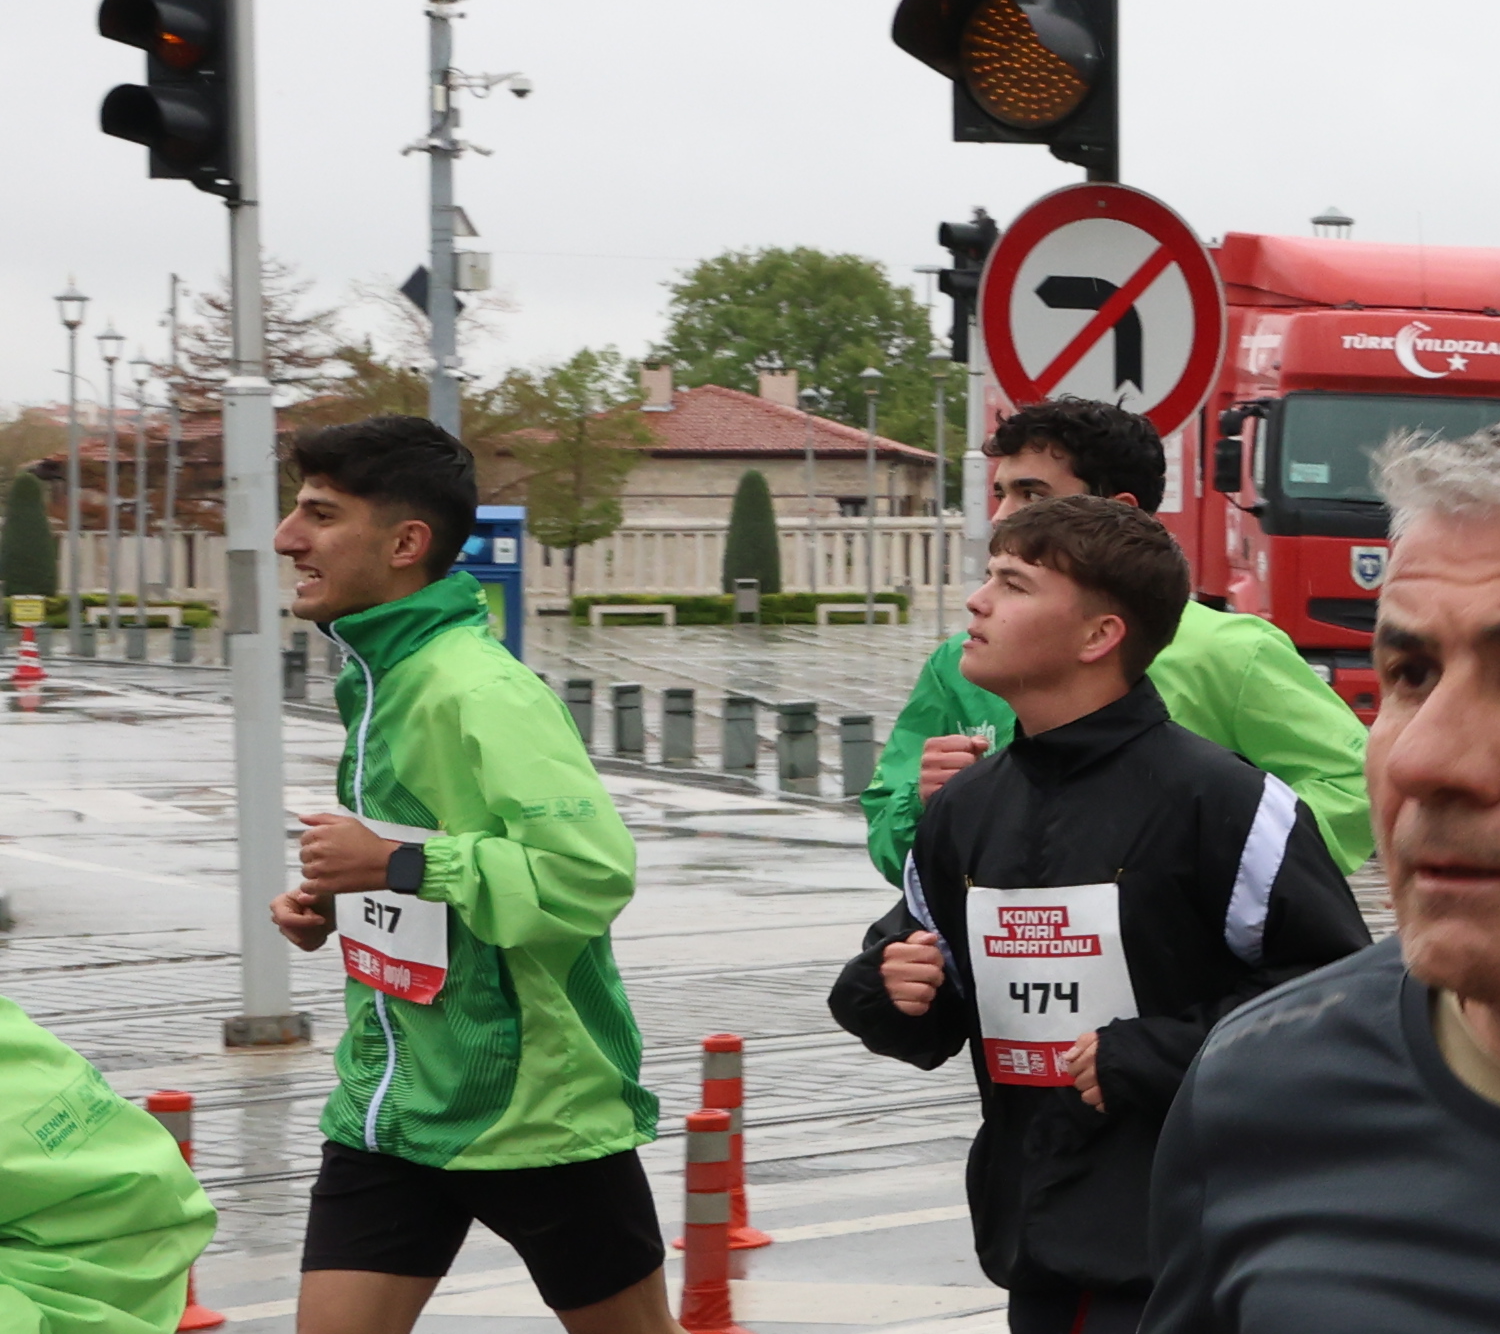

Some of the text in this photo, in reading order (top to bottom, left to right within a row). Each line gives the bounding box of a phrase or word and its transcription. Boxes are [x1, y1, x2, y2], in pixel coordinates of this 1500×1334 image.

[1340, 332, 1396, 350] TÜRK
[363, 896, 402, 934] 217
[1001, 909, 1063, 924] KONYA
[1013, 925, 1055, 939] YARI
[989, 938, 1093, 954] MARATONU
[1009, 981, 1079, 1014] 474
